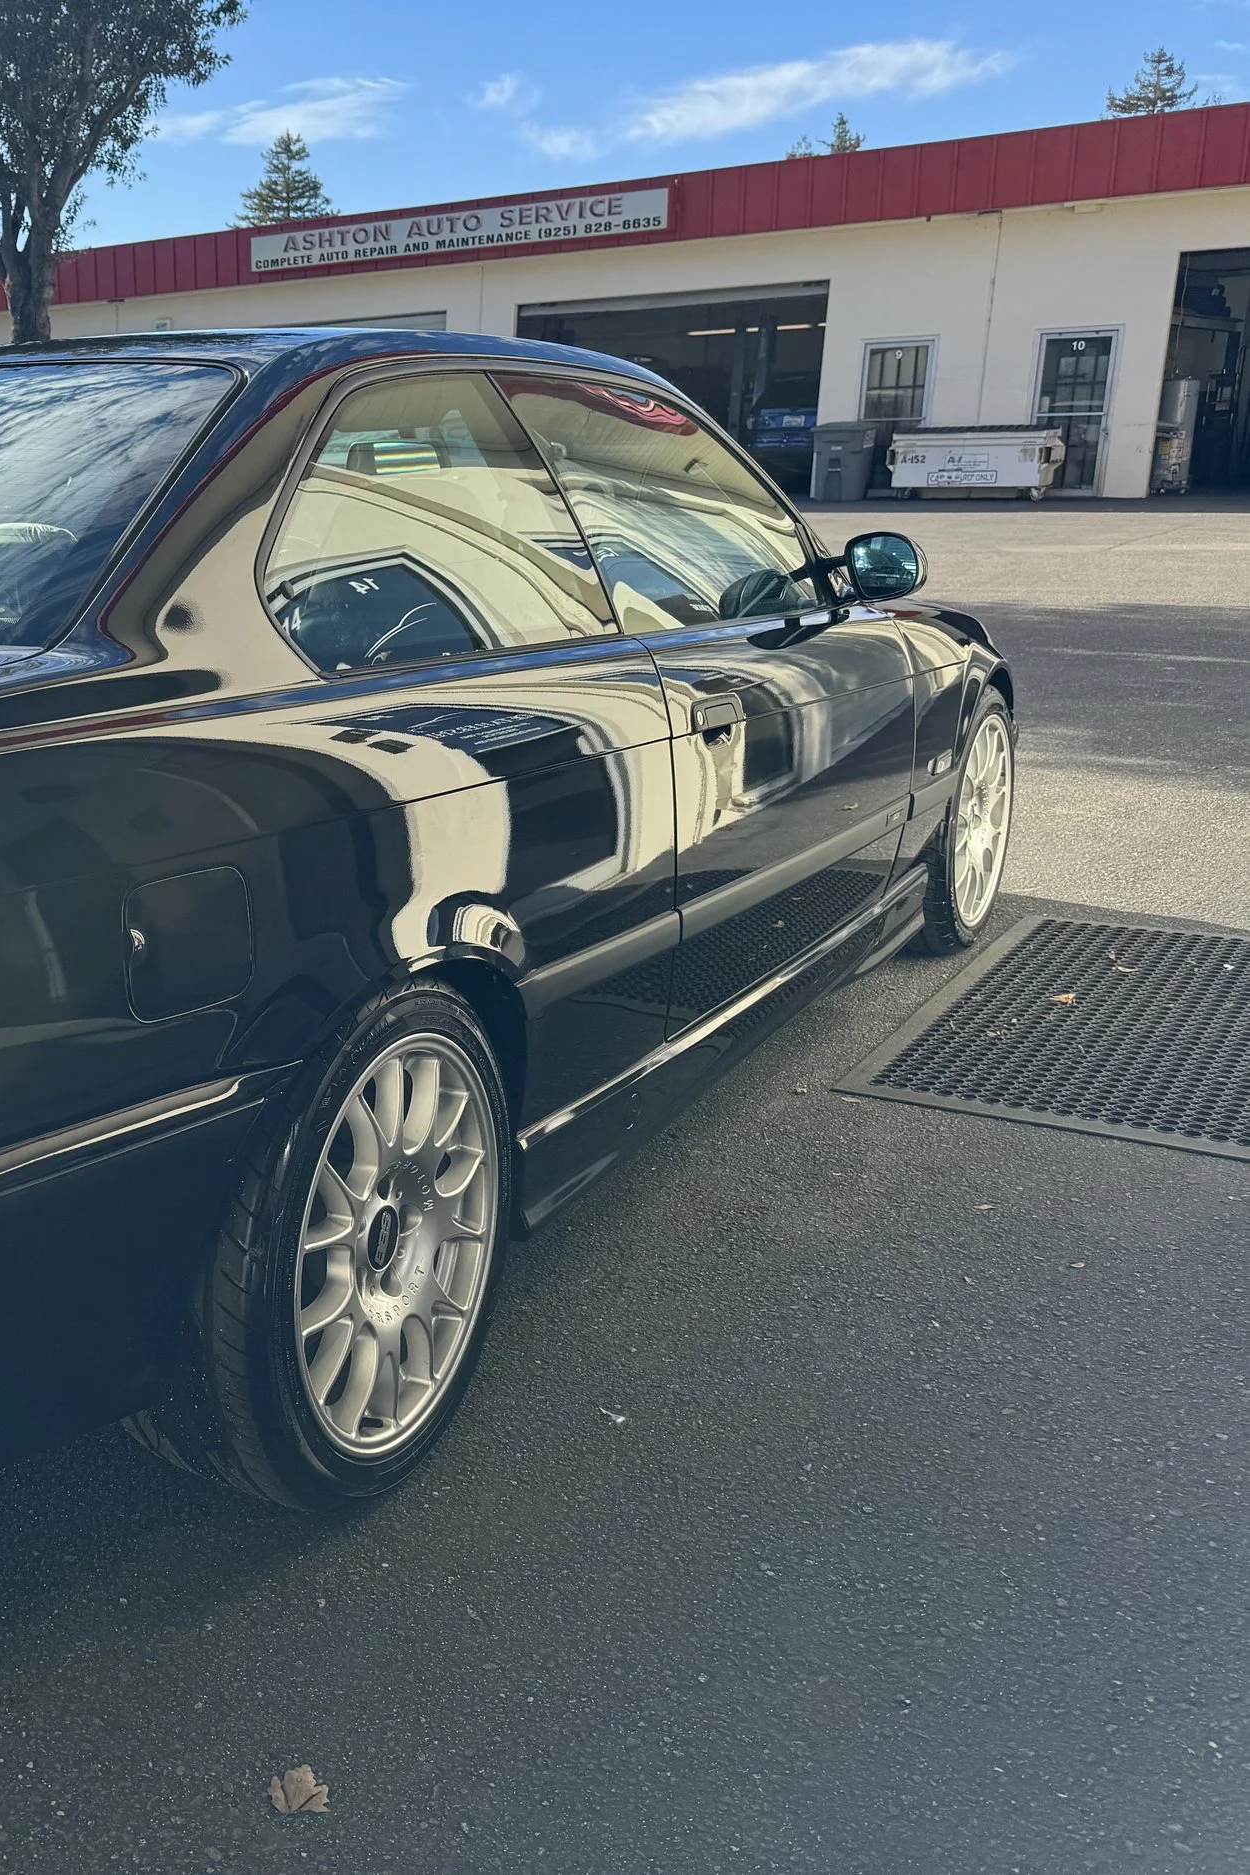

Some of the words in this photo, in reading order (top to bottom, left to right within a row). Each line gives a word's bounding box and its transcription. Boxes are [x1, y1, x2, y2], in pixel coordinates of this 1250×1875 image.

[255, 254, 313, 270] COMPLETE
[318, 250, 348, 263] AUTO
[354, 244, 397, 259] REPAIR
[403, 241, 429, 254] AND
[435, 229, 531, 250] MAINTENANCE
[537, 224, 577, 240] (925)
[584, 216, 662, 235] 828-6635
[282, 223, 392, 254] ASHTON
[406, 212, 483, 239] AUTO
[499, 196, 624, 229] SERVICE
[895, 350, 903, 359] 9
[1071, 341, 1086, 350] 10
[374, 1210, 393, 1267] BBS
